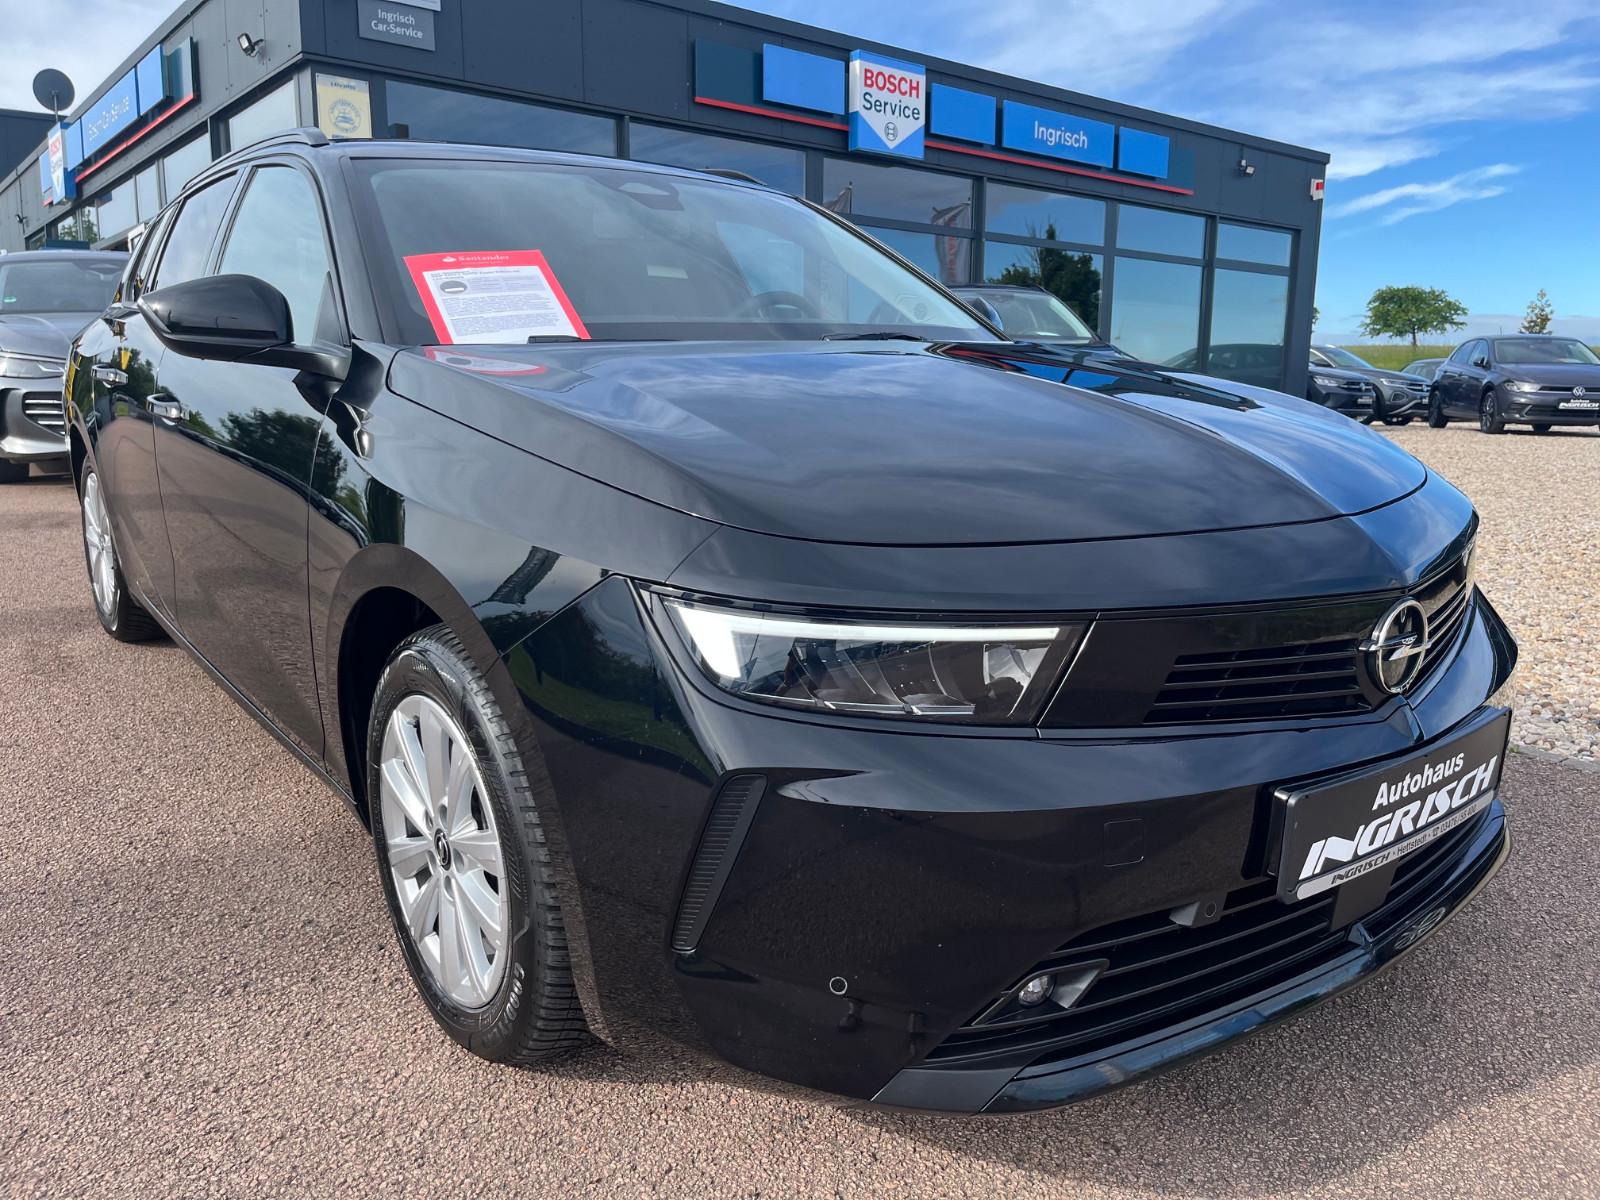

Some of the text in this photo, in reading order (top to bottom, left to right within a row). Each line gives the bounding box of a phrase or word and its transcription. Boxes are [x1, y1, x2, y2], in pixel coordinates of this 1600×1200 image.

[371, 20, 423, 39] Car-Service
[378, 9, 415, 25] Ingrisch
[864, 68, 920, 99] BOSCH
[862, 92, 921, 120] Service
[1034, 120, 1088, 149] Ingrisch
[458, 254, 509, 262] Santander
[1372, 753, 1464, 811] Autohaus
[1299, 755, 1498, 881] INGRISCH
[1331, 852, 1390, 885] INGRISCH
